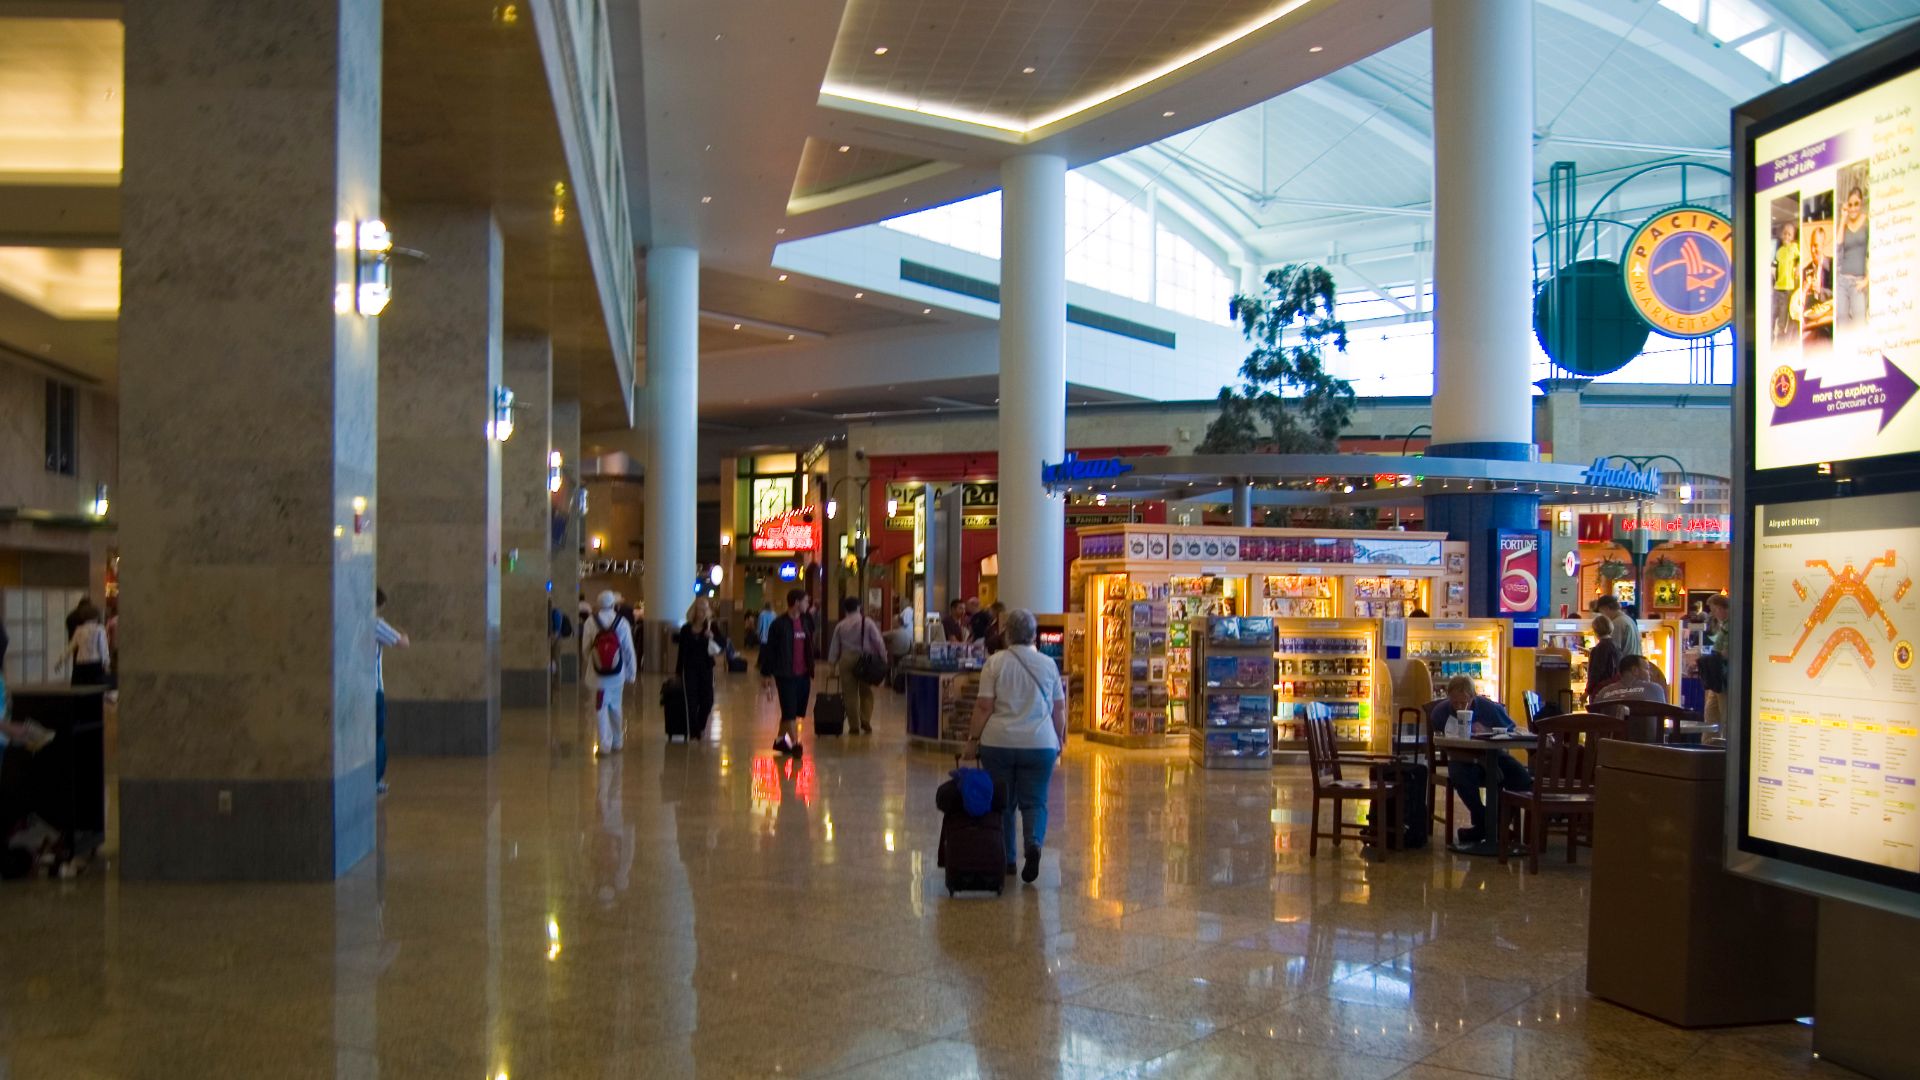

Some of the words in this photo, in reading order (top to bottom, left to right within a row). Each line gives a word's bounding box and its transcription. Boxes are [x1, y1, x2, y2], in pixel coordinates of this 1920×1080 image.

[1789, 163, 1799, 176] of
[1799, 159, 1816, 173] Life
[1635, 215, 1732, 258] PACIFI
[1633, 281, 1732, 329] MARKETPLA
[1812, 391, 1833, 404] more
[1834, 389, 1843, 400] to
[1826, 403, 1835, 412] on
[1836, 398, 1867, 410] Concourse
[1880, 393, 1886, 403] D
[1582, 457, 1649, 491] Hudson
[892, 487, 943, 504] PIZA
[1768, 519, 1790, 529] Airport
[1791, 517, 1820, 527] Directory
[1500, 539, 1538, 551] FORTUNE
